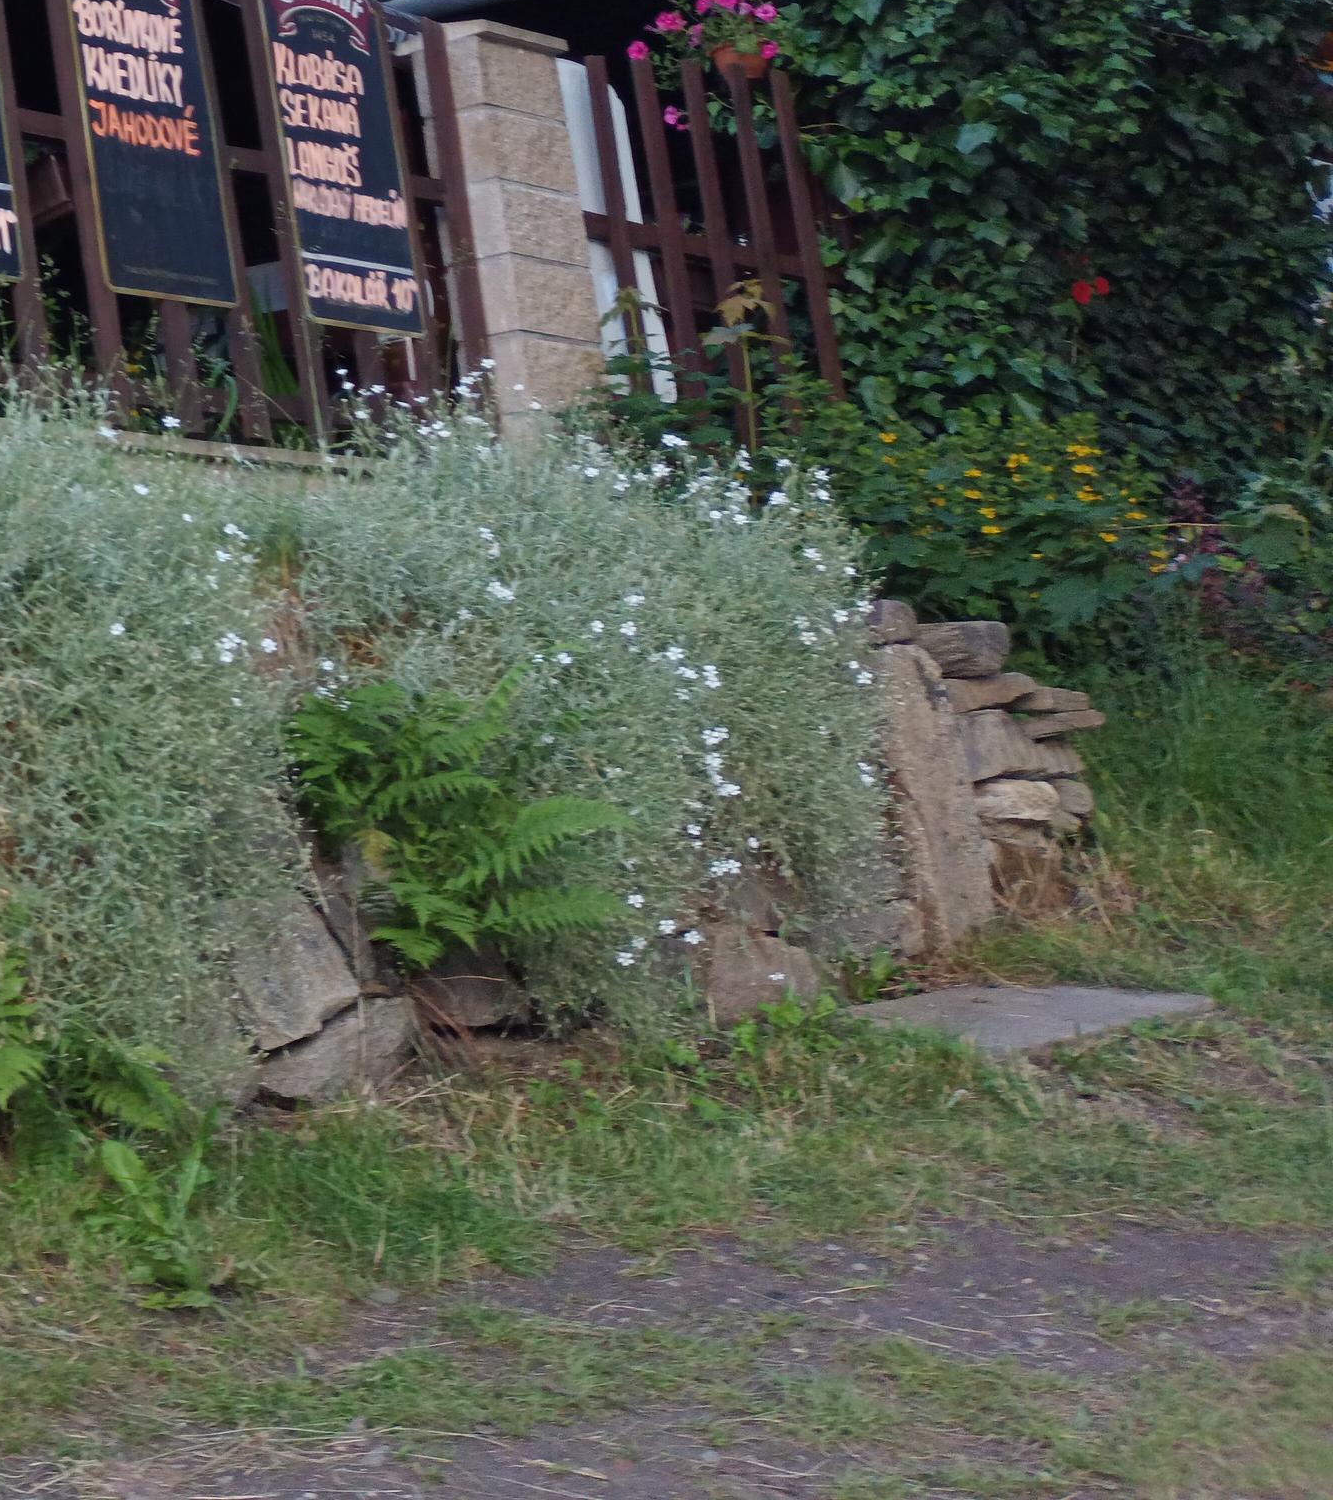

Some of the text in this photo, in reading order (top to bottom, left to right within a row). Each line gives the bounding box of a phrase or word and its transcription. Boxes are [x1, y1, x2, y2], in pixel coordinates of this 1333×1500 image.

[81, 42, 183, 107] KNEDLÍKY
[272, 41, 365, 96] KLOBÁSA
[88, 99, 202, 158] JAHODOVÉ
[279, 87, 362, 139] SEKANÁ
[305, 263, 392, 311] BAKALÁŘ
